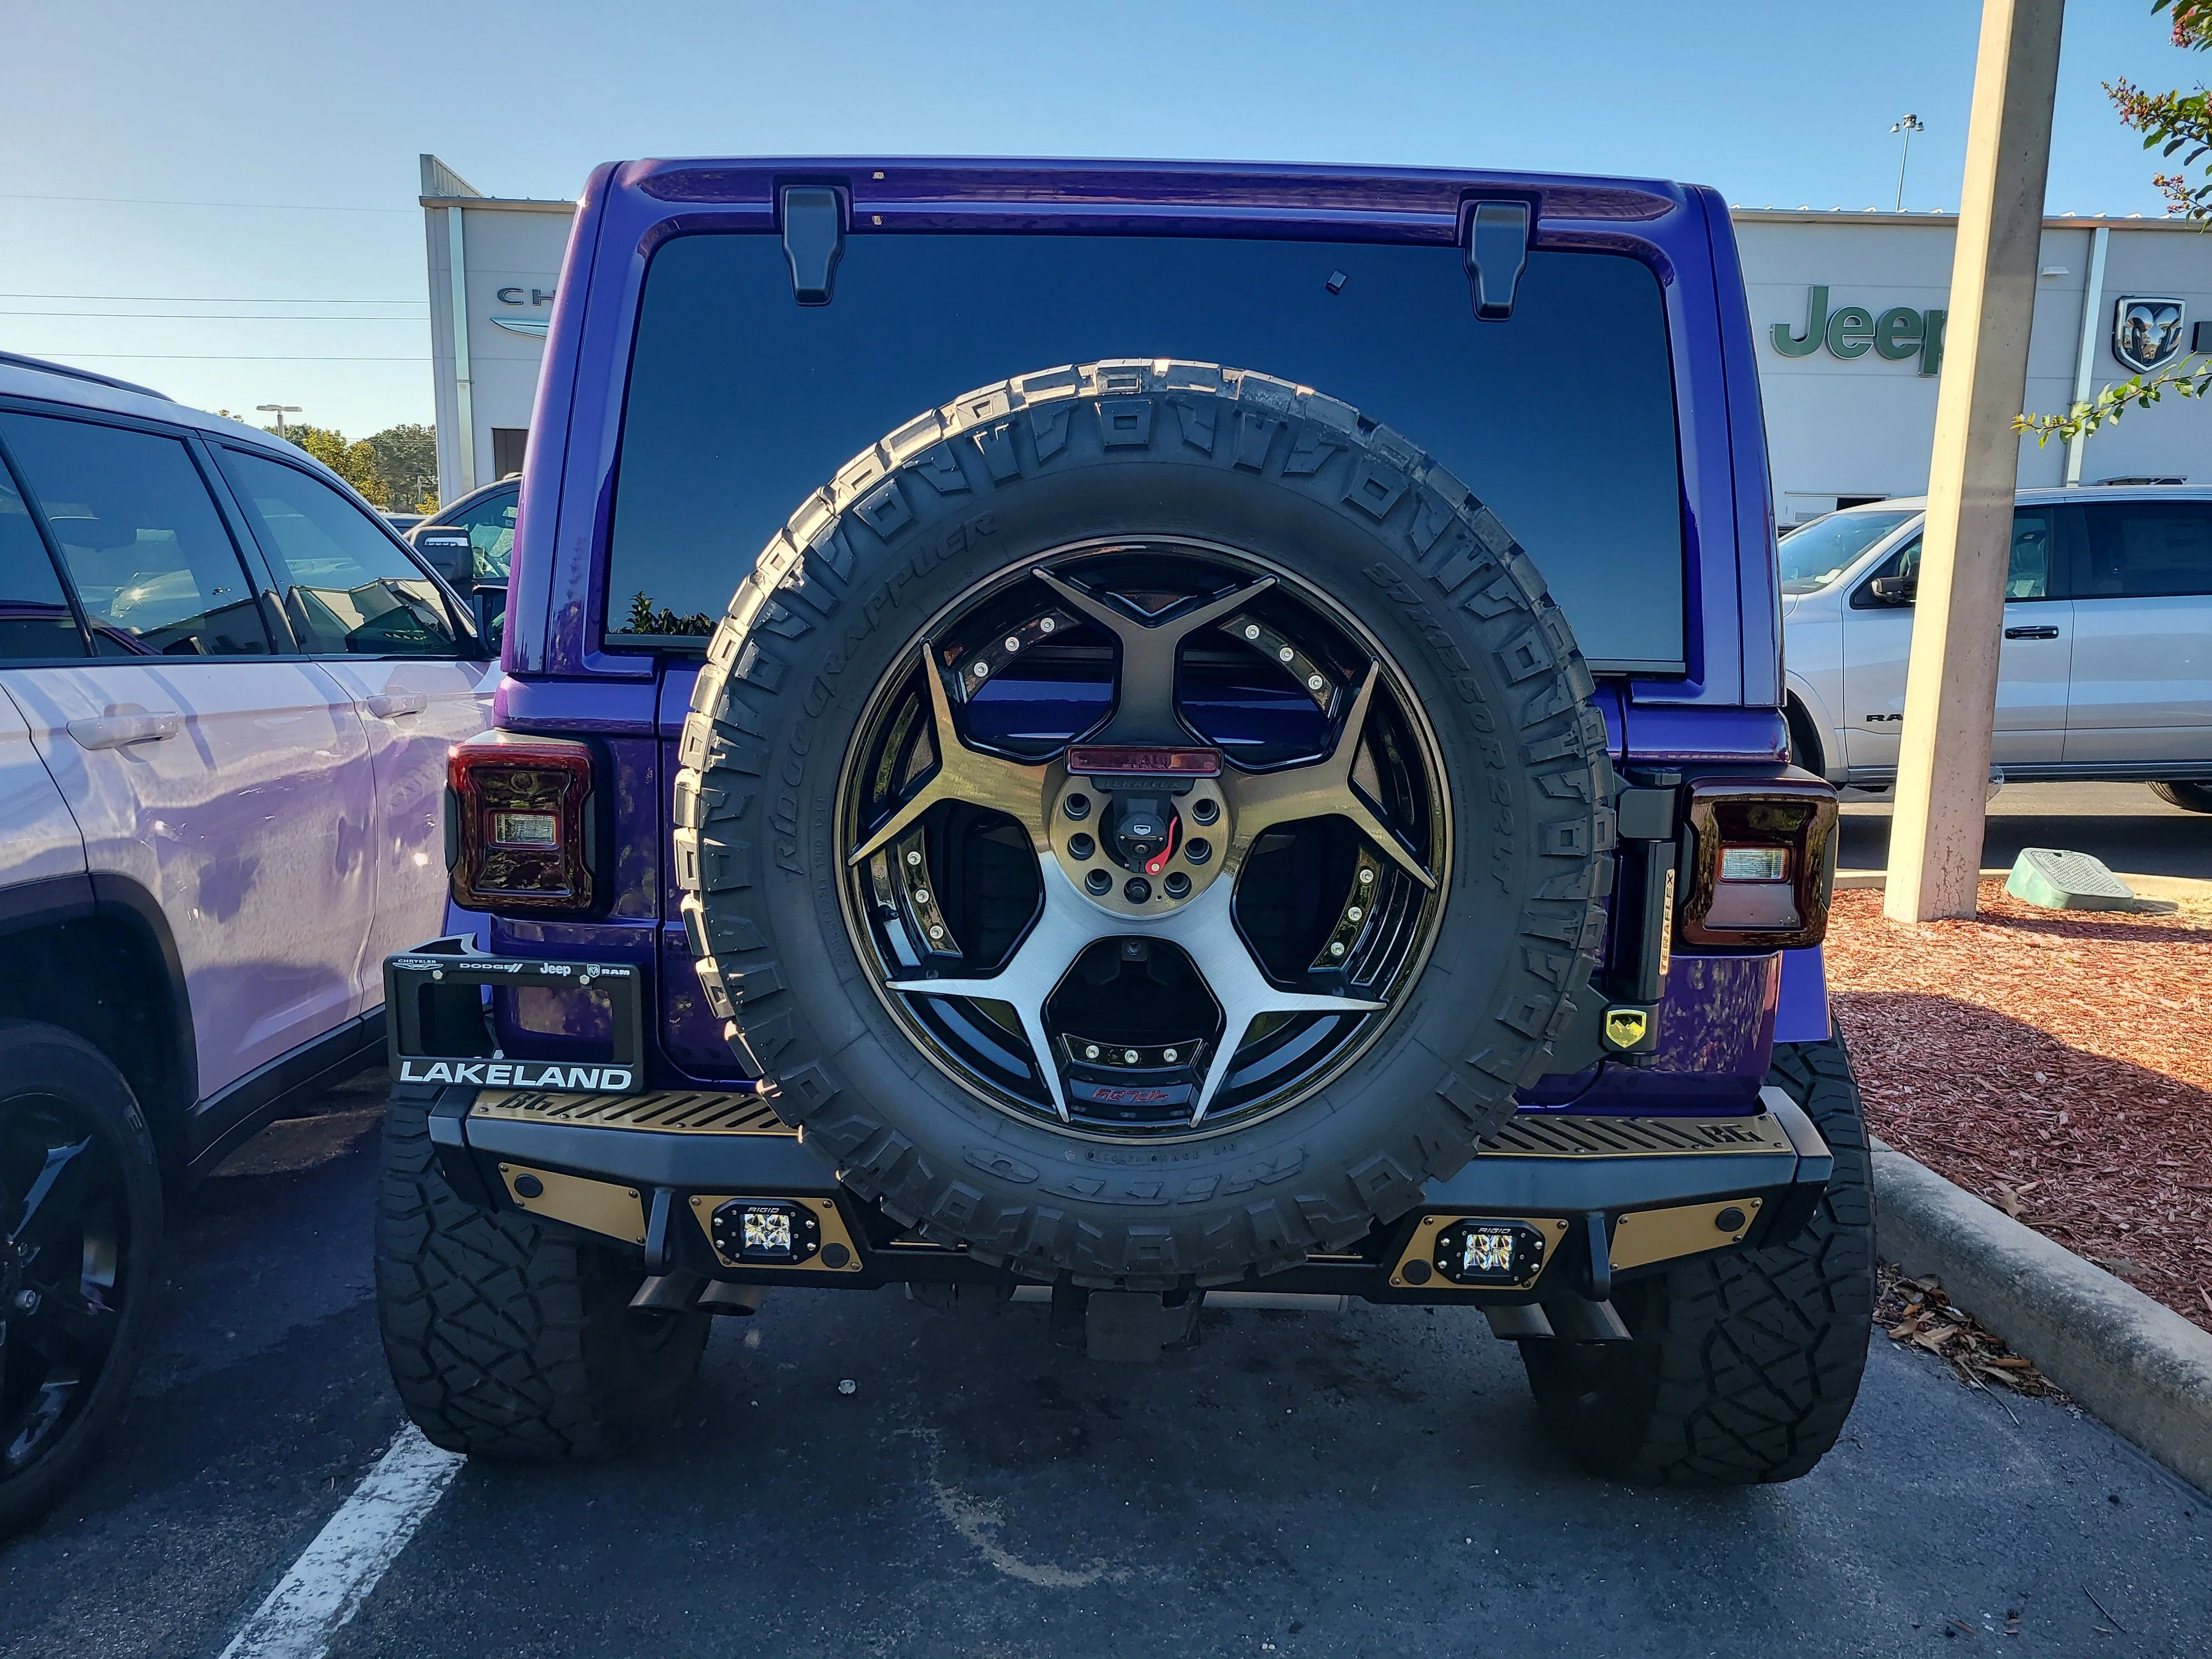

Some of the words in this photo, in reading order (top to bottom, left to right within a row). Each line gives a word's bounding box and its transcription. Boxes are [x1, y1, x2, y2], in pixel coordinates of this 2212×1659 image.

[769, 719, 815, 874] RIDGE
[805, 511, 998, 717] GRAPPLER
[1866, 714, 1903, 722] RA
[1104, 780, 1181, 788] TERAFLEX
[1661, 872, 1674, 970] TERAFLEX
[540, 962, 572, 976] Jeep
[400, 1061, 633, 1090] LAKELAND
[963, 1143, 1306, 1206] NITTO
